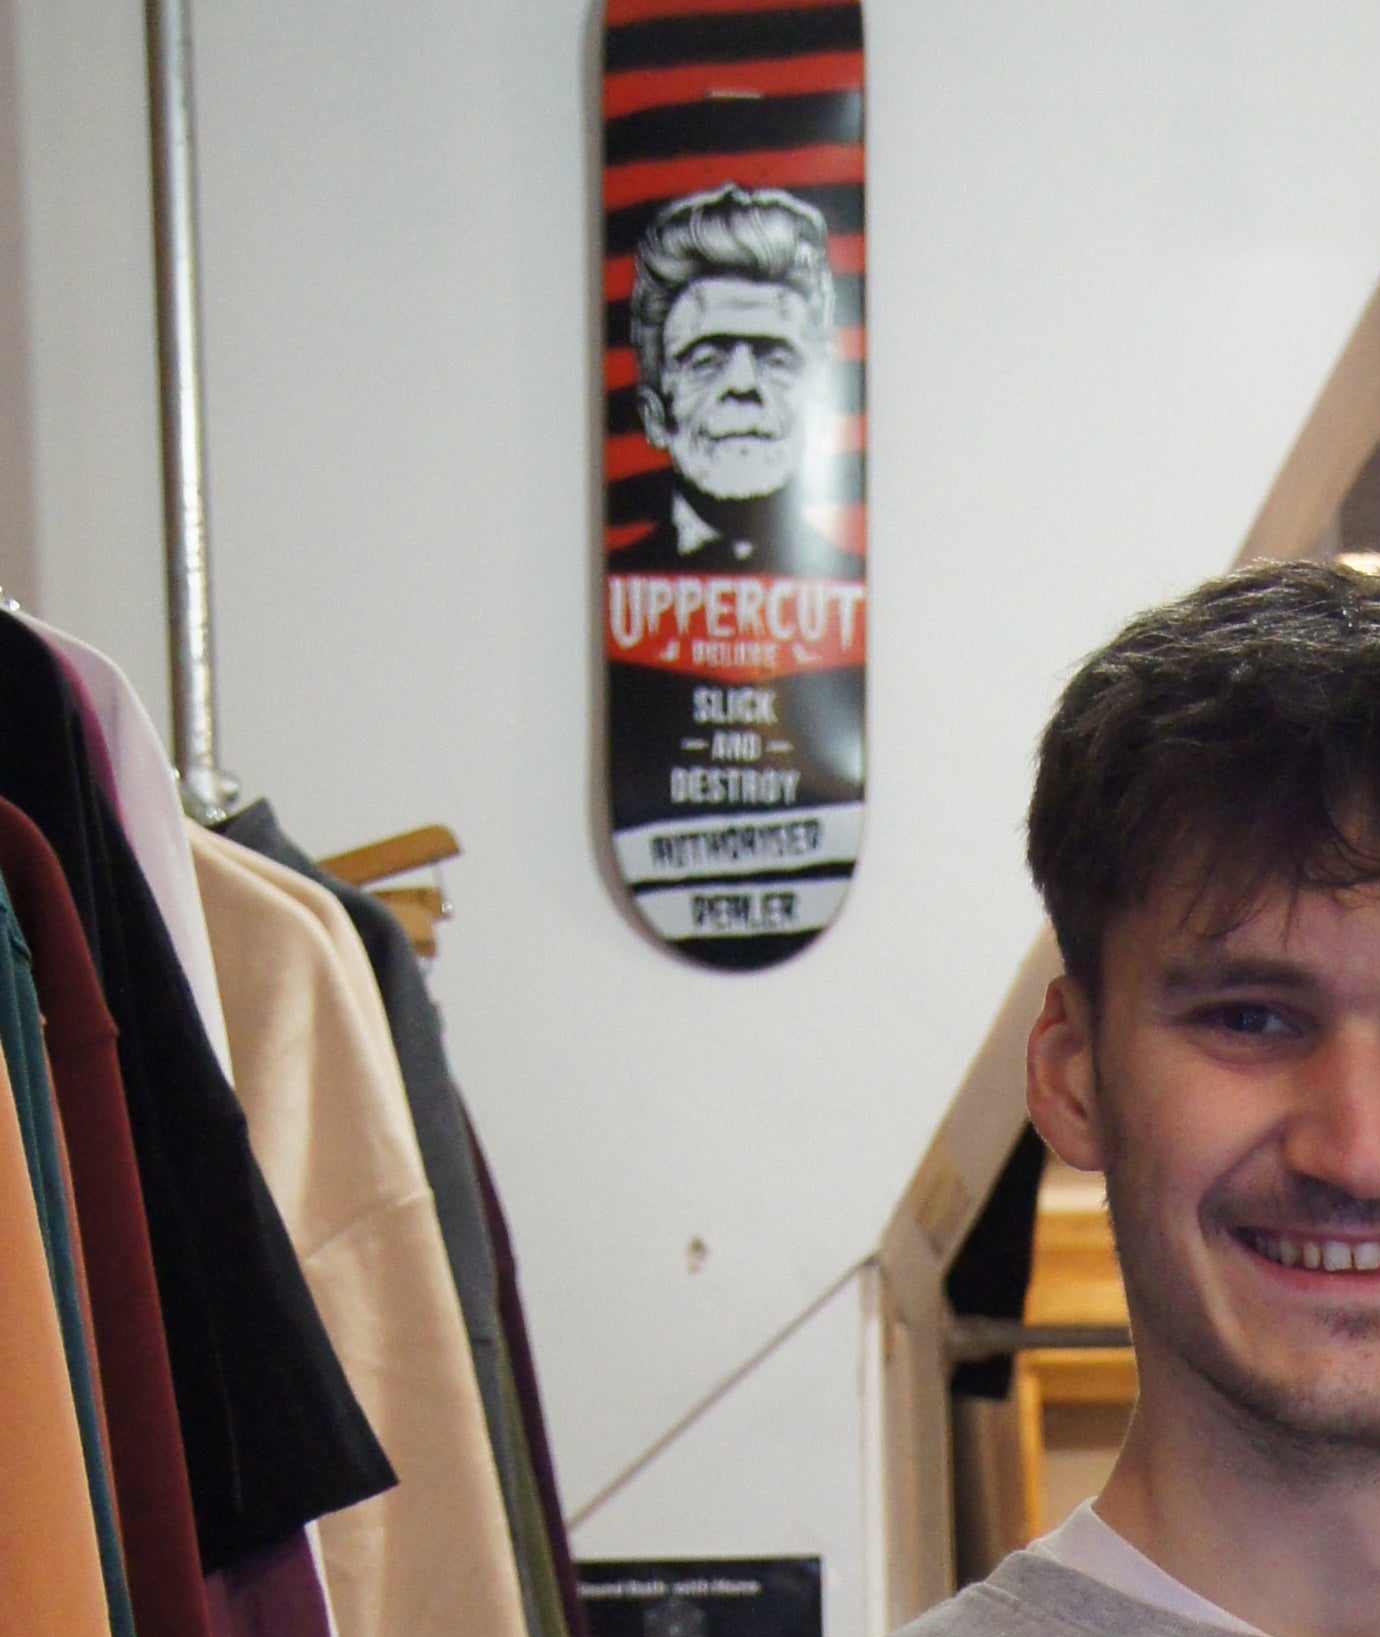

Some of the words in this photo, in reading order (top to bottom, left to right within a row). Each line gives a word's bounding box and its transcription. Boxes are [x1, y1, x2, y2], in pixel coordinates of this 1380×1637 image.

[608, 576, 865, 650] UPPERCUT
[692, 686, 777, 724] SLICK
[710, 730, 761, 761] AND
[670, 767, 799, 803] DESTROY
